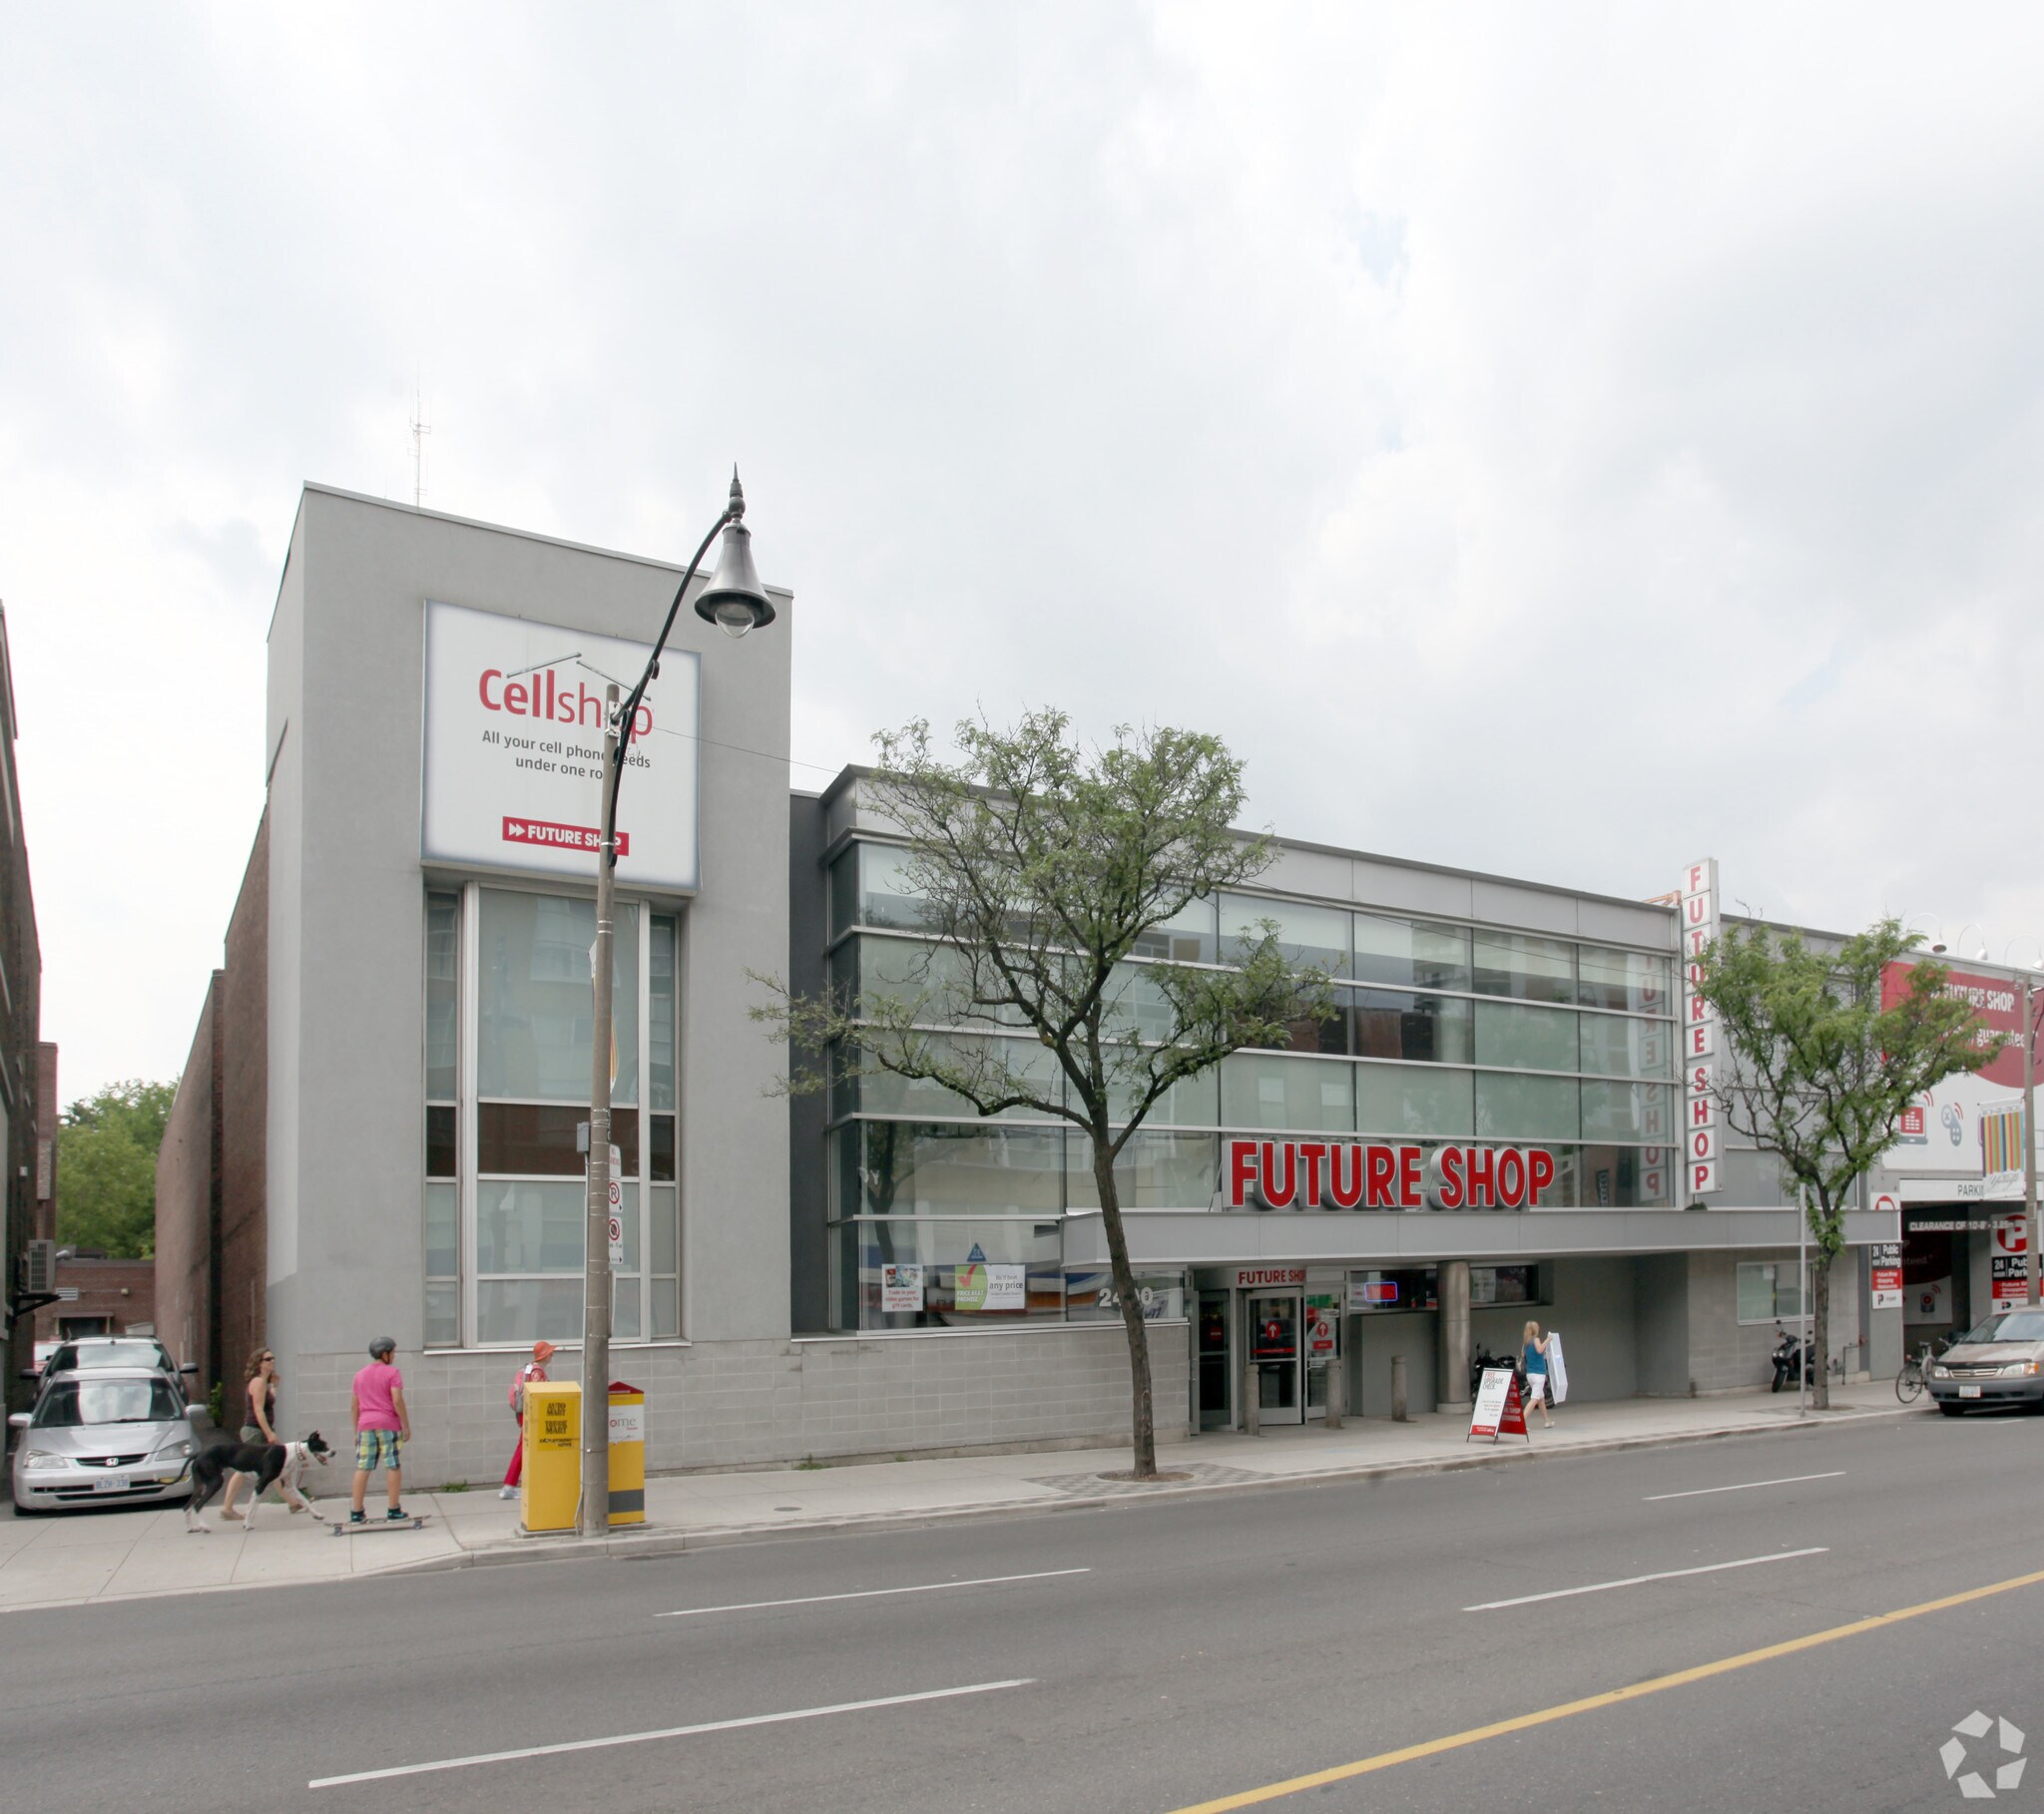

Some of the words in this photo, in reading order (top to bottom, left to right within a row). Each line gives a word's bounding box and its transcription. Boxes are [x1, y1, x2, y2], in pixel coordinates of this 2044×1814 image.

[479, 669, 653, 743] Cellshp
[482, 730, 500, 744] All
[504, 735, 536, 749] your
[539, 741, 562, 754] cell
[621, 755, 651, 768] eeds
[516, 757, 556, 772] under
[560, 763, 585, 777] one
[590, 769, 603, 780] ro
[528, 825, 582, 845] FUTURE
[585, 834, 622, 848] SHP
[1688, 865, 1706, 1055] FUTURE
[1987, 990, 2015, 1012] SHOP
[1693, 1066, 1710, 1192] SHOP
[1231, 1140, 1423, 1208] FUTURE
[1439, 1144, 1555, 1209] SHOP
[1958, 1184, 1984, 1196] PARKI
[1909, 1222, 1955, 1231] CLEARANCE
[1883, 1244, 1899, 1255] Public
[1881, 1256, 1901, 1268] Parking
[1994, 1260, 2004, 1270] 24
[2011, 1258, 2028, 1267] Pub
[989, 1283, 1004, 1291] any
[1005, 1281, 1023, 1290] price
[1238, 1269, 1286, 1284] FUTURE
[1099, 1287, 1154, 1307] 240
[610, 1418, 636, 1427] ome
